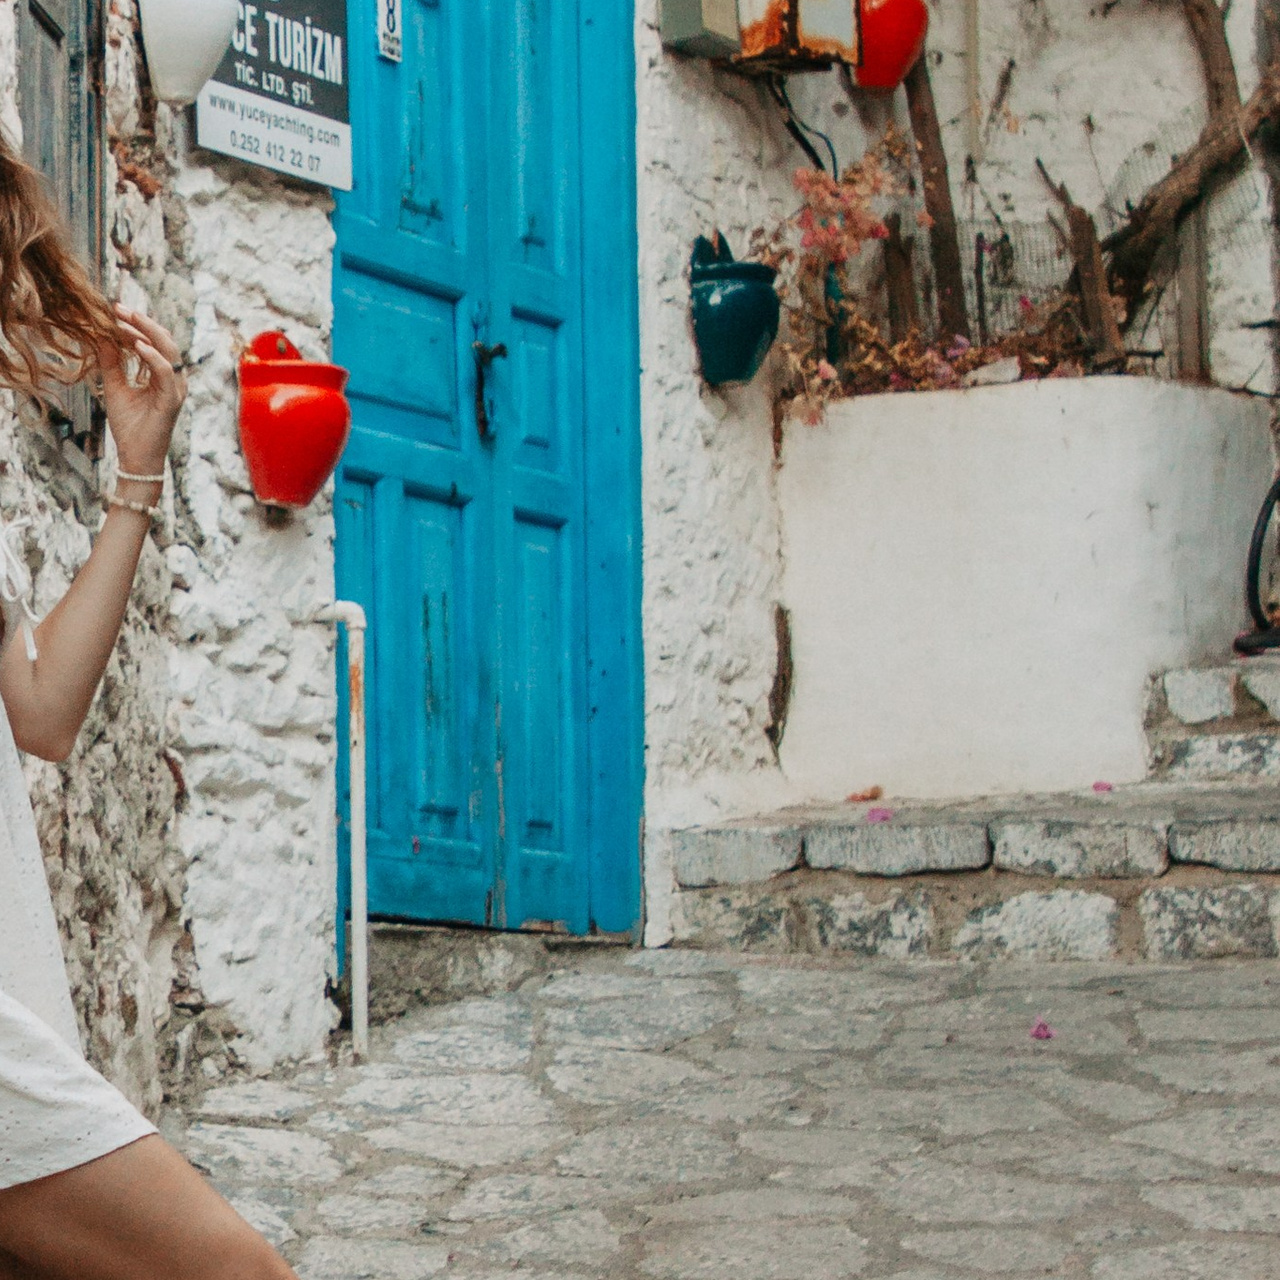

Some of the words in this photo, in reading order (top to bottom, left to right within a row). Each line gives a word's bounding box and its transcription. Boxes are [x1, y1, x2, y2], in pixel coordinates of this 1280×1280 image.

[265, 11, 342, 85] TURİZM
[235, 60, 259, 86] TİC.
[262, 71, 288, 97] LTD.
[208, 93, 340, 147] www.yuceyachting.com
[230, 130, 260, 155] 0.252
[266, 141, 284, 163] 412
[290, 150, 303, 168] 22
